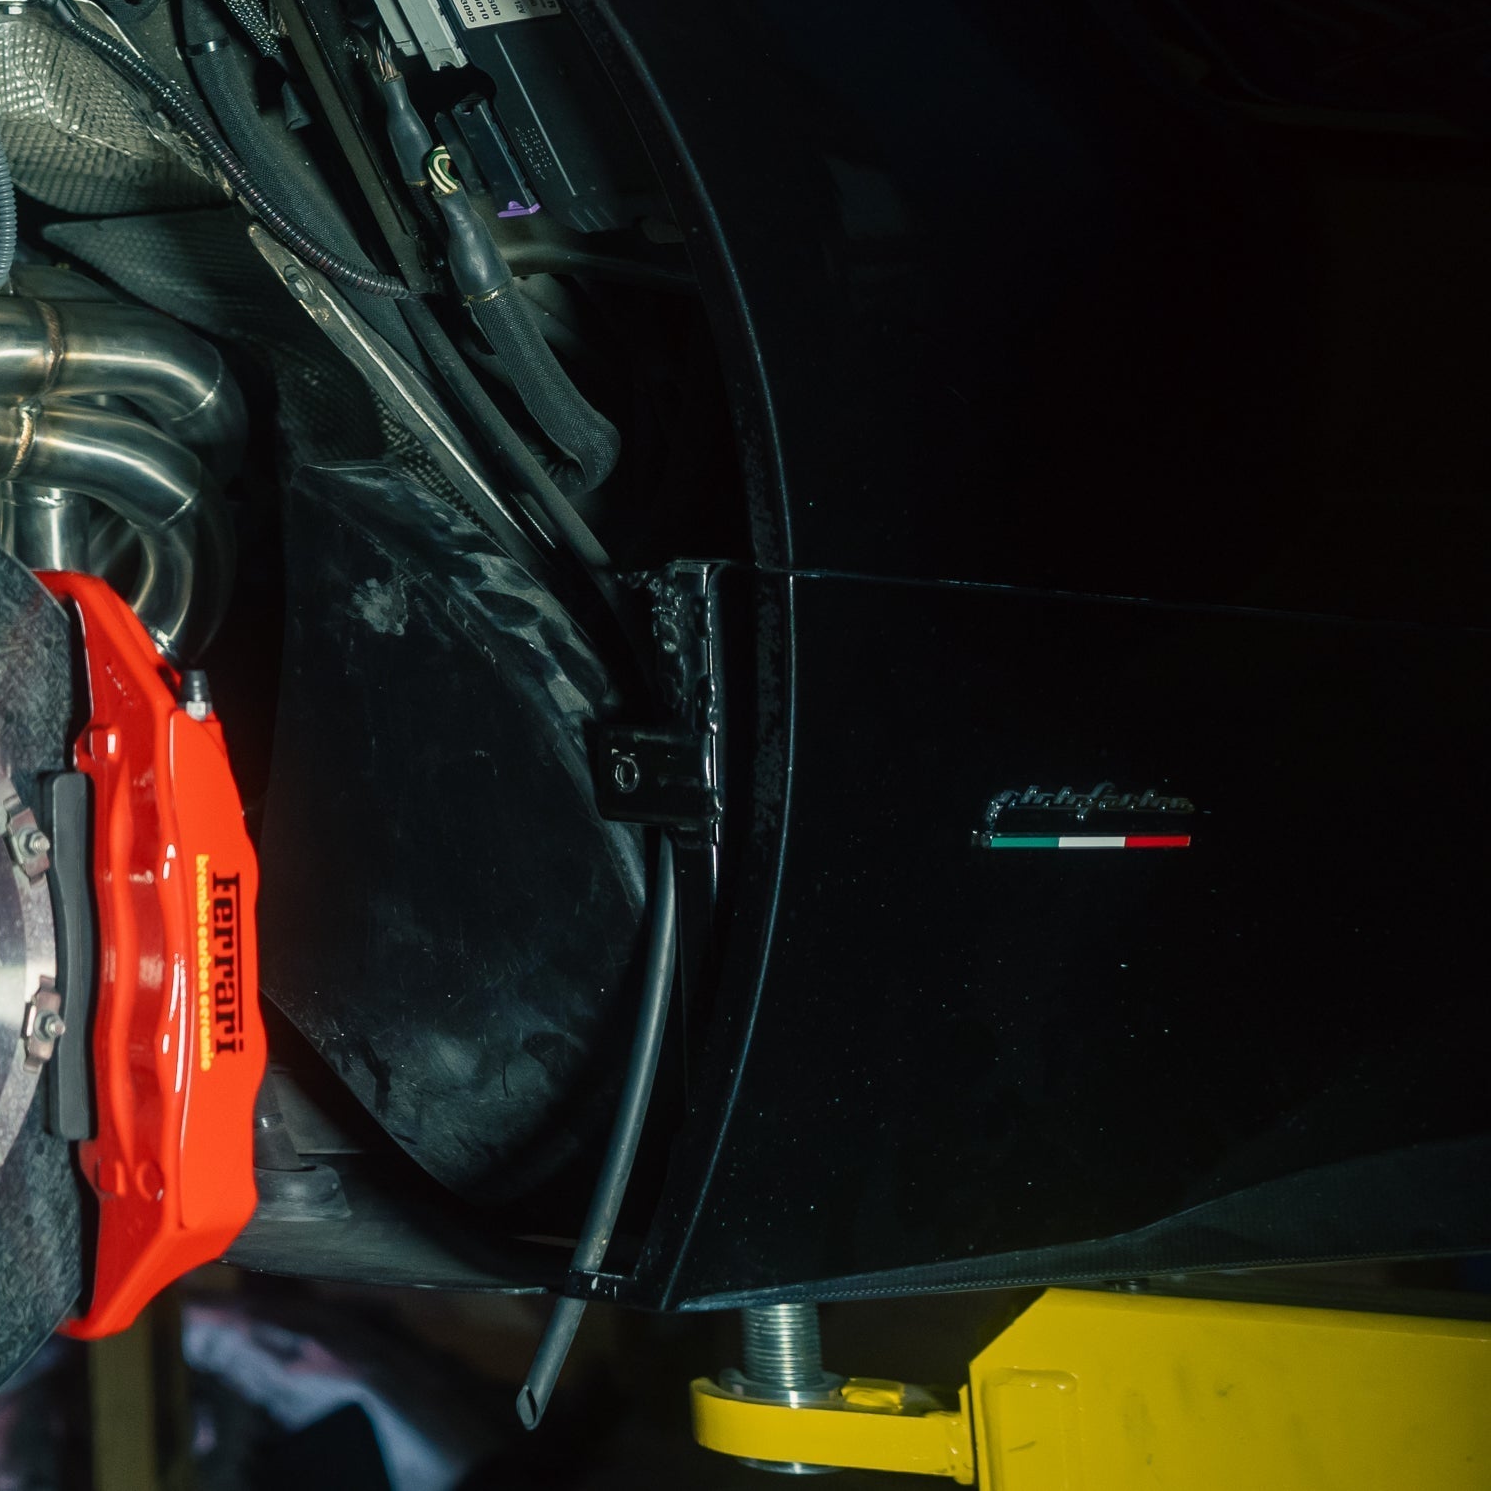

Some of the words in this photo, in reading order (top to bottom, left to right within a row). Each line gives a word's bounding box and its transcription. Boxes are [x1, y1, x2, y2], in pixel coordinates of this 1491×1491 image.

[514, 0, 526, 14] 12V
[196, 853, 211, 925] brembo
[197, 926, 212, 992] carbon
[213, 871, 243, 1054] Ferrari
[199, 994, 215, 1071] ceramic
